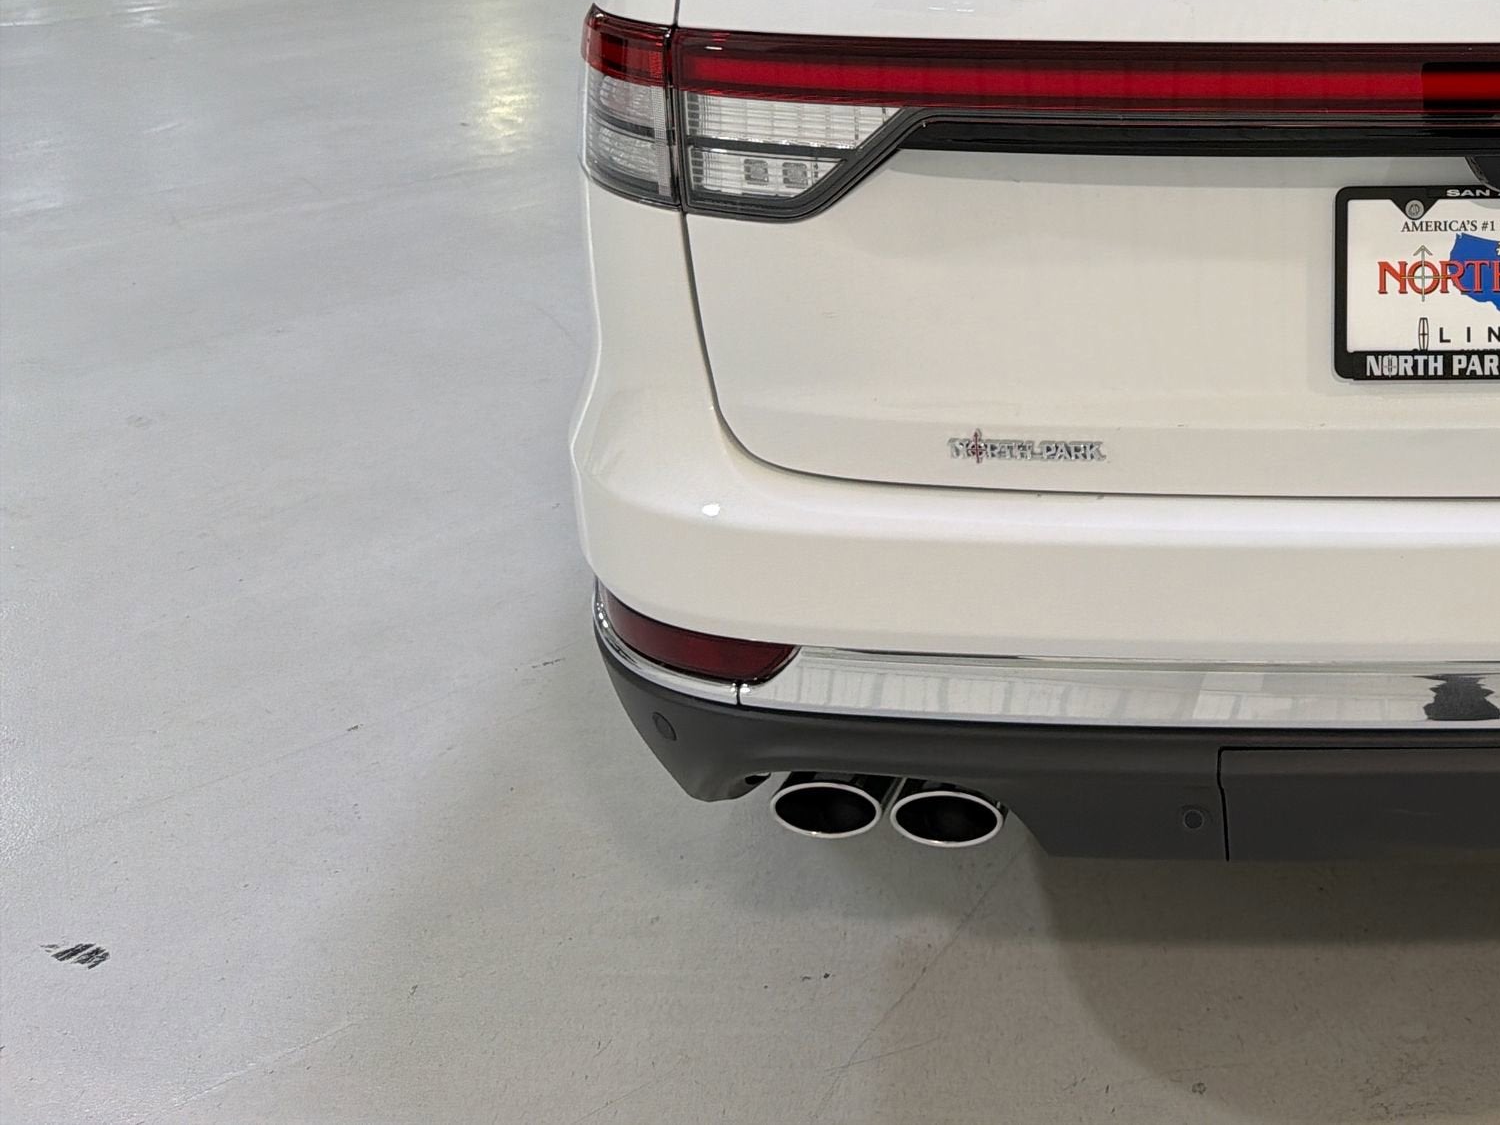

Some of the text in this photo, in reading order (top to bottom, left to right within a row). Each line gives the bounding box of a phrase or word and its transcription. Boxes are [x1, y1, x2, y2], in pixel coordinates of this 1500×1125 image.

[1446, 188, 1491, 197] SAN
[1401, 219, 1478, 233] AMERICA'S
[1481, 220, 1496, 232] #1
[1366, 354, 1444, 376] NORTH
[948, 438, 1106, 462] NORTH PARK
